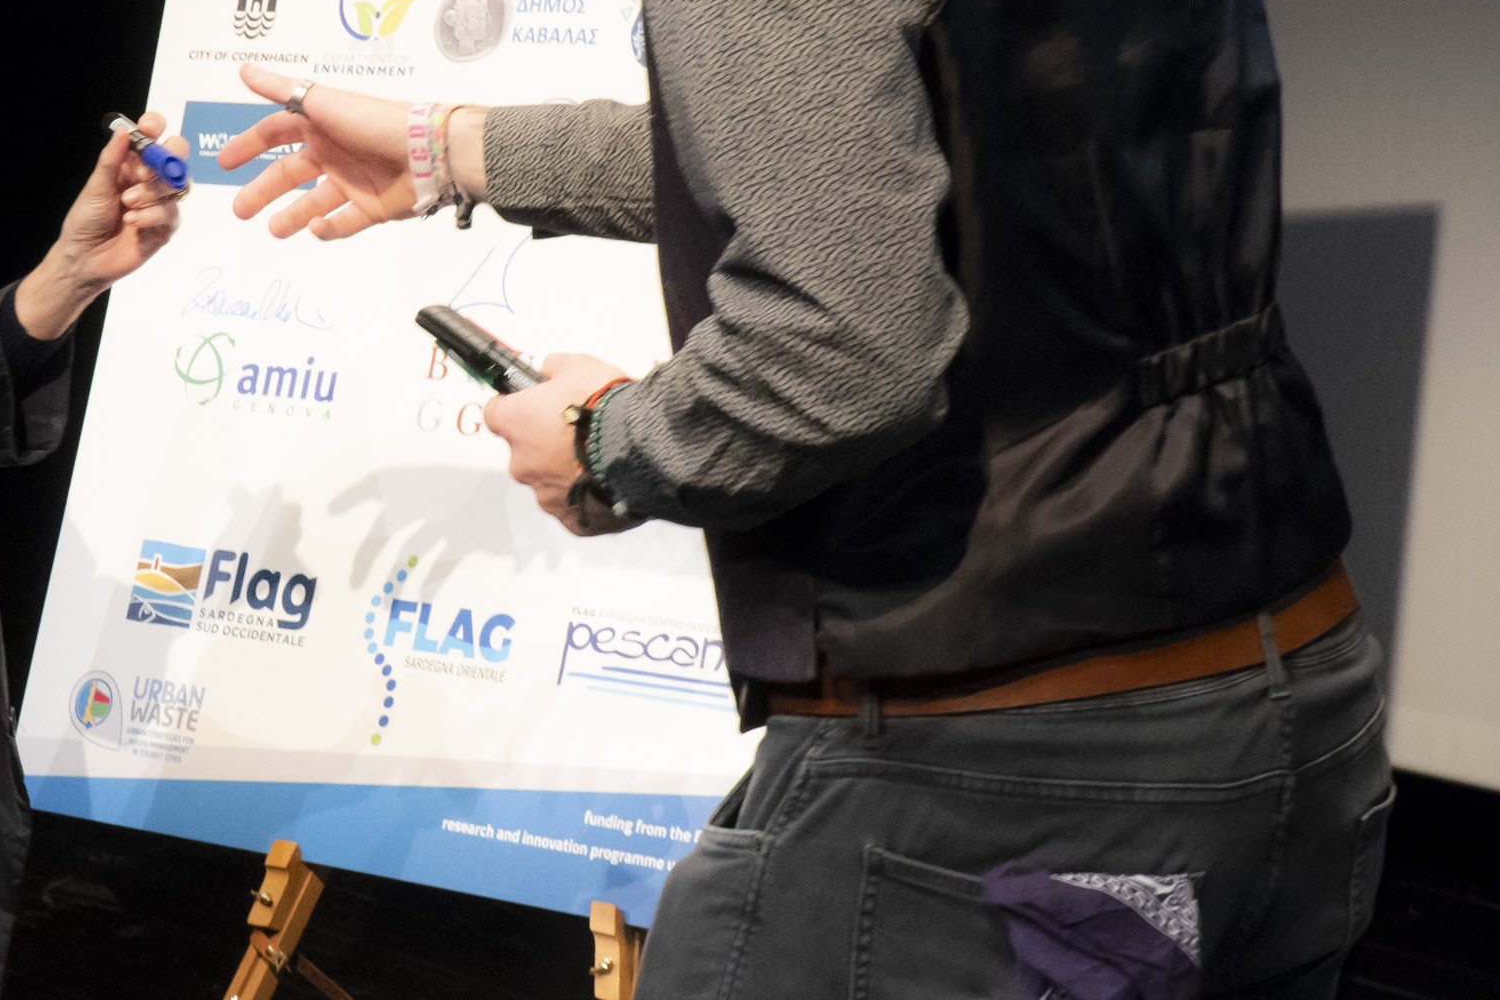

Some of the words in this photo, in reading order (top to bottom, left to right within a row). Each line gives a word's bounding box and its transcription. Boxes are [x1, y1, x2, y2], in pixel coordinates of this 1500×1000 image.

[511, 27, 599, 46] ΚΑΒΑΛΑΣ
[188, 50, 213, 61] CITY
[214, 50, 229, 61] OF
[231, 51, 309, 64] COPENHAGEN
[313, 63, 417, 77] ENVIRONMENT
[237, 357, 338, 403] amiu
[232, 401, 332, 421] GENOVA
[204, 549, 318, 630] Flag
[199, 607, 275, 628] SARDEGNA
[572, 606, 596, 617] FLAG
[196, 621, 219, 634] SUD
[223, 626, 306, 647] OCCIDENTALE
[383, 598, 516, 663] FLAG
[404, 656, 454, 674] SARDEGNA
[456, 665, 507, 683] ORIENTALE
[133, 675, 206, 711] URBAN
[130, 699, 199, 732] WASTE
[584, 810, 633, 836] funding
[636, 819, 667, 840] from
[670, 826, 691, 843] the
[442, 819, 494, 839] research
[497, 827, 520, 844] and
[522, 830, 587, 856] innovation
[589, 846, 664, 870] programme
